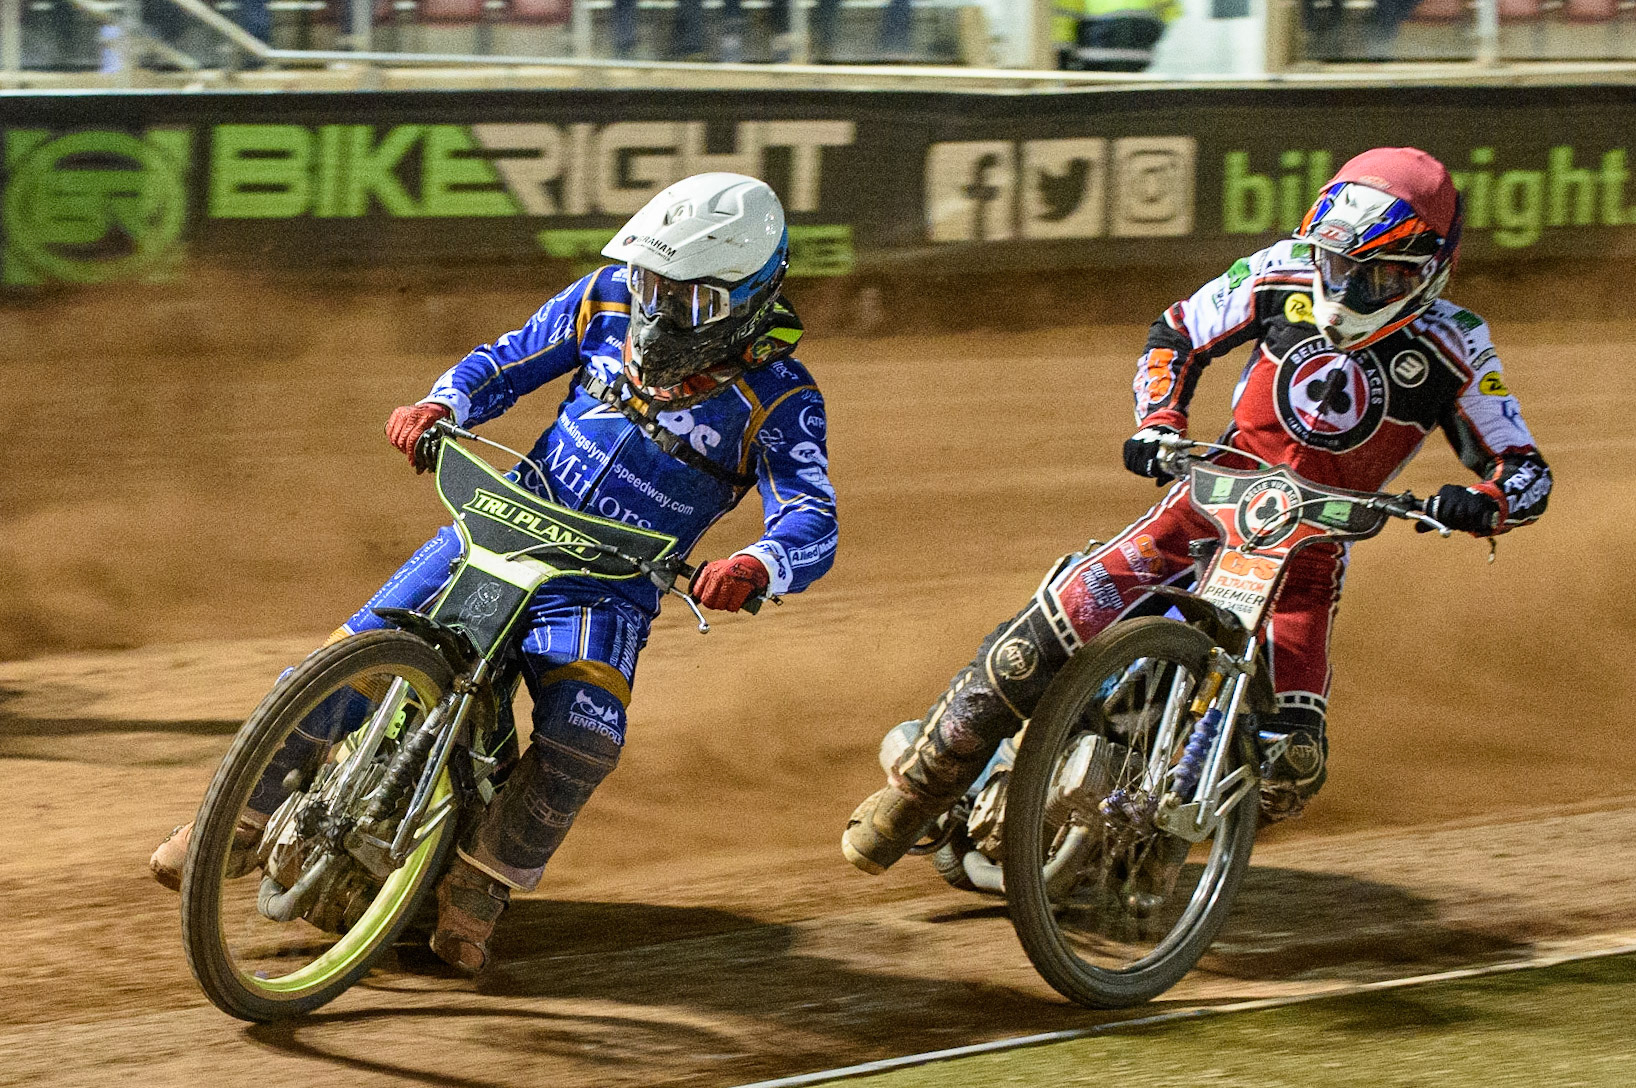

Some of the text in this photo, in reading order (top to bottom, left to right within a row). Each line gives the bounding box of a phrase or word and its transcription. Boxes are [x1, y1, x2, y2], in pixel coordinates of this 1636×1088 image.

[1365, 368, 1384, 406] ACES
[475, 494, 593, 554] TRU PLANT
[1204, 585, 1266, 606] PREMIER
